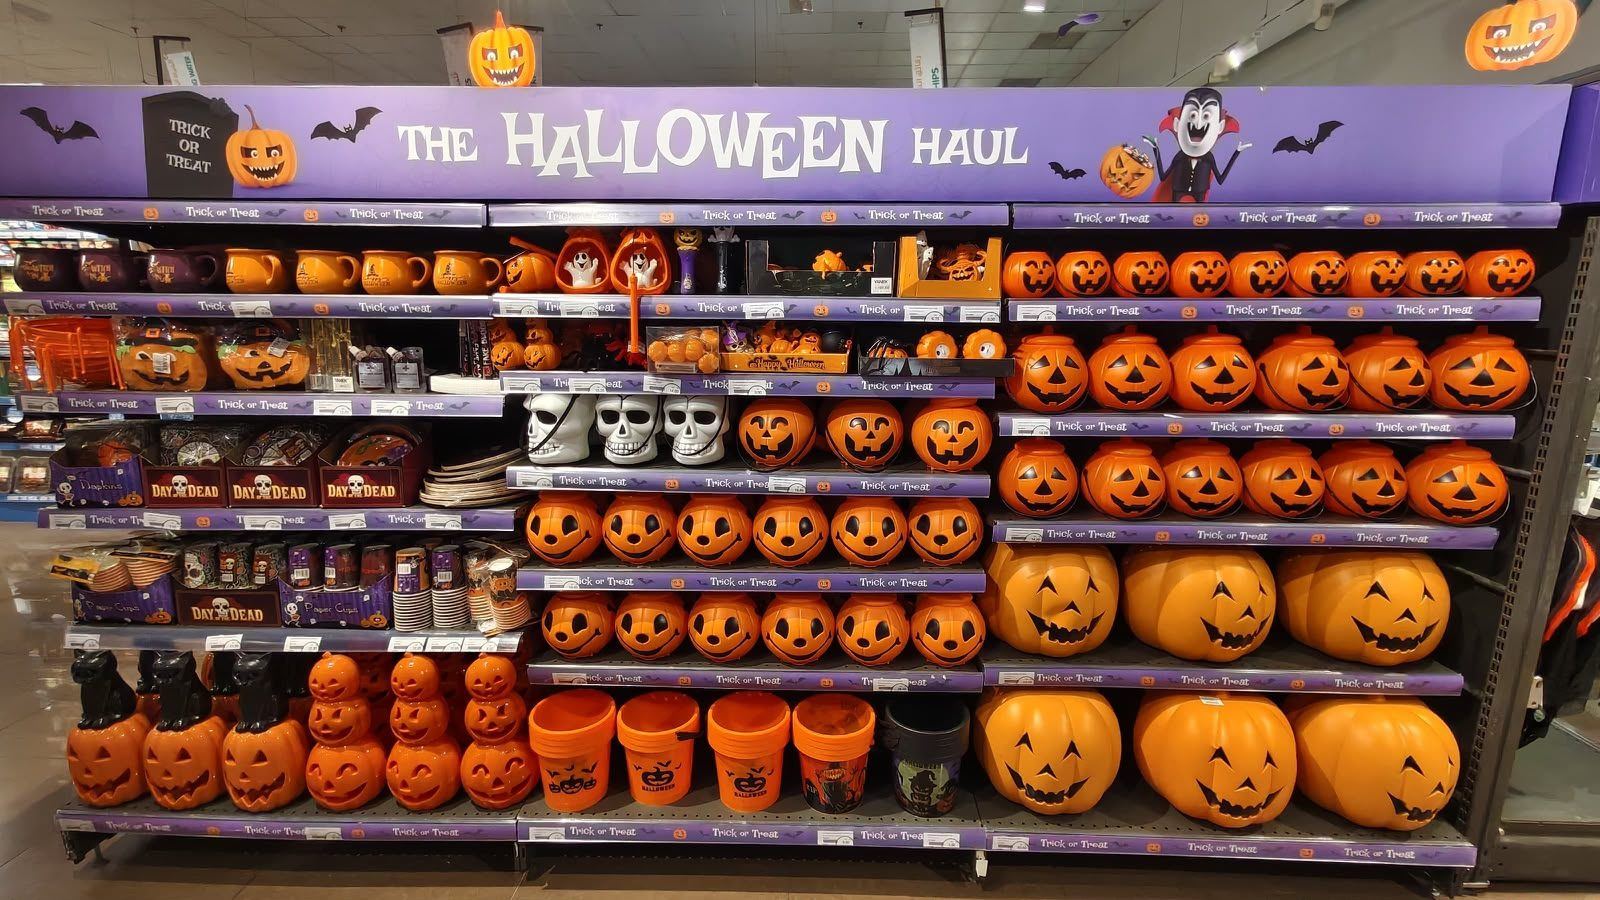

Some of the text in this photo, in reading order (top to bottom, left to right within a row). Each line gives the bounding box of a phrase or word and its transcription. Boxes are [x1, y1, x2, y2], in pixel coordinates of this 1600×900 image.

[184, 55, 197, 79] WATER
[169, 118, 212, 141] TRICK
[179, 138, 201, 156] OR
[397, 107, 1029, 180] THE HALLOWEEN HAUL
[167, 152, 212, 175] TREAT
[33, 206, 58, 215] Trick
[74, 206, 103, 216] Treat
[186, 207, 213, 217] Trick
[230, 208, 259, 218] Treat
[350, 208, 377, 218] Trick
[394, 209, 423, 219] Treat
[703, 210, 730, 220] Trick
[747, 211, 776, 220] Treat
[869, 210, 896, 219] Trick
[913, 211, 943, 220] Treat
[1074, 213, 1101, 223] Trick
[1119, 213, 1149, 223] Treat
[1240, 212, 1268, 222] Trick
[1286, 212, 1317, 223] Treat
[1415, 212, 1443, 222] Trick
[1462, 212, 1493, 222] Treat
[47, 300, 74, 310] Trick
[88, 301, 118, 311] Treat
[198, 301, 226, 311] Trick
[359, 302, 387, 312] Trick
[402, 303, 431, 313] Treat
[697, 302, 724, 312] Trick
[860, 304, 887, 314] Trick
[1066, 306, 1093, 315] Trick
[1110, 306, 1139, 315] Treat
[1226, 305, 1254, 315] Trick
[1271, 306, 1302, 315] Treat
[1397, 305, 1425, 315] Trick
[1442, 305, 1472, 315] Treat
[483, 346, 491, 366] FAKE
[757, 357, 825, 369] Happy Halloween
[703, 380, 730, 390] Trick
[861, 380, 888, 391] Trick
[904, 382, 933, 391] Treat
[69, 398, 94, 407] Trick
[110, 399, 138, 408] Treat
[218, 400, 244, 409] Trick
[260, 400, 288, 409] Treat
[416, 401, 444, 410] Treat
[1056, 421, 1082, 431] Trick
[1098, 422, 1127, 431] Treat
[1211, 422, 1237, 431] Trick
[1254, 423, 1284, 432] Treat
[1376, 423, 1403, 432] Trick
[1420, 423, 1451, 432] Treat
[80, 480, 123, 491] Napkins
[559, 475, 584, 485] Trick
[599, 477, 627, 486] Treat
[706, 478, 731, 487] Trick
[152, 484, 218, 498] DAY DEAD
[327, 484, 395, 498] DAY DEAD
[861, 481, 886, 491] Trick
[902, 482, 930, 491] Treat
[235, 485, 307, 499] DAY DEAD
[90, 515, 115, 524] Trick
[388, 515, 414, 524] Trick
[1047, 530, 1072, 538] Trick
[1089, 530, 1115, 538] Treat
[1197, 530, 1223, 539] Trick
[1240, 532, 1268, 540] Treat
[1357, 533, 1382, 542] Trick
[1400, 535, 1429, 543] Treat
[607, 577, 633, 586] Treat
[710, 577, 735, 586] Trick
[750, 578, 776, 586] Treat
[860, 578, 885, 587] Trick
[900, 579, 927, 587] Treat
[304, 602, 358, 614] Paper Cups
[191, 606, 264, 622] DAY DEAD
[616, 675, 642, 683] Treat
[716, 675, 741, 684] Trick
[755, 676, 782, 685] Treat
[1036, 673, 1061, 682] Trick
[1076, 674, 1103, 683] Treat
[1181, 676, 1205, 684] Trick
[1222, 677, 1249, 685] Treat
[1334, 679, 1360, 688] Trick
[1376, 680, 1404, 689] Treat
[245, 826, 270, 835] Trick
[392, 826, 417, 836] Trick
[432, 828, 459, 836] Treat
[570, 827, 594, 835] Trick
[610, 827, 636, 835] Treat
[713, 828, 778, 838] Trick Treat
[861, 830, 885, 839] Trick
[1041, 839, 1108, 848] Trick Treat
[1188, 843, 1258, 853] Trick Treat
[1344, 848, 1370, 857] Trick
[1386, 849, 1415, 858] Treat
